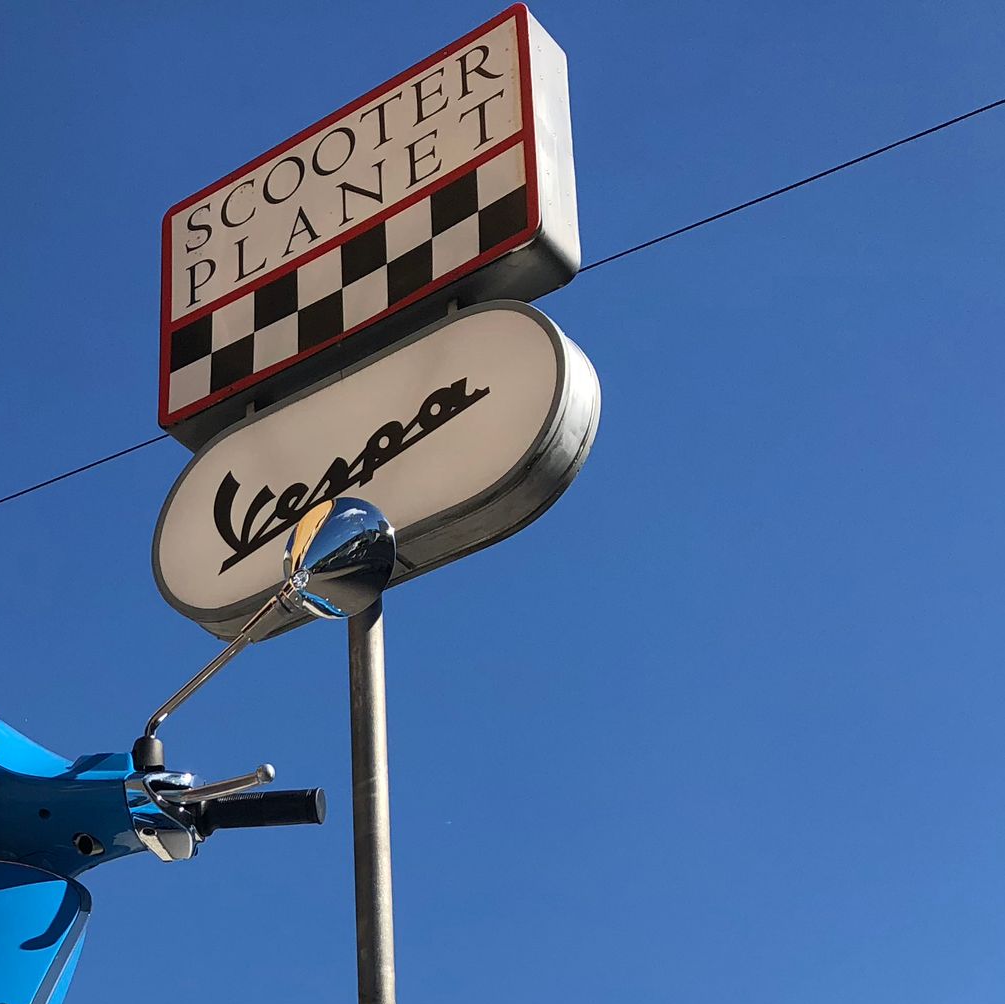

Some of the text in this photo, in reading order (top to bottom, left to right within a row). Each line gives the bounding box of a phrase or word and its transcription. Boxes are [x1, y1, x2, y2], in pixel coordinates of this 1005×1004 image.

[184, 43, 505, 255] SCOOTER
[184, 88, 506, 309] PLANET
[212, 376, 491, 576] Vespa
